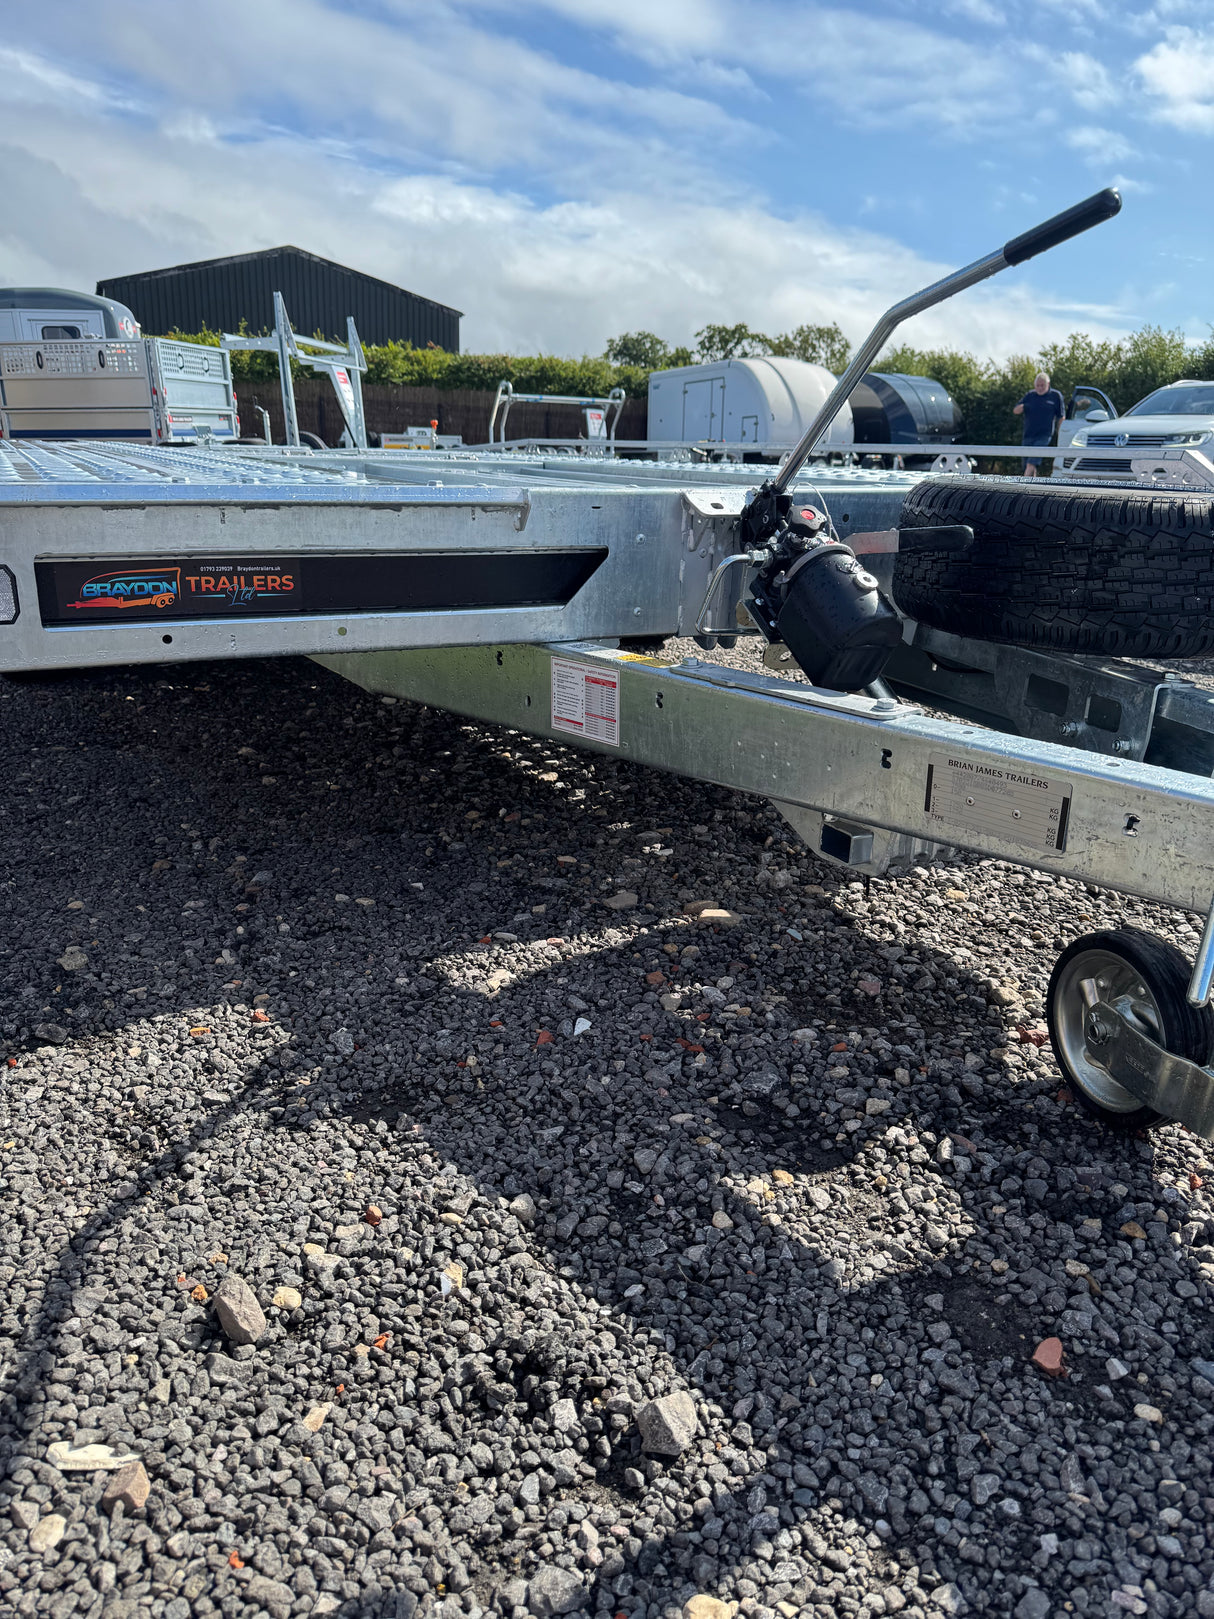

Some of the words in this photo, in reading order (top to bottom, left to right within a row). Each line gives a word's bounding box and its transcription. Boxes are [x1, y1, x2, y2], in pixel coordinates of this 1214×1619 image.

[82, 581, 177, 597] BRAYDON
[186, 575, 295, 592] TRAILERS
[227, 584, 256, 606] Ltd
[948, 759, 974, 772] BRIAN
[975, 765, 1003, 778] JAMES
[1005, 772, 1049, 789] TRAILERS
